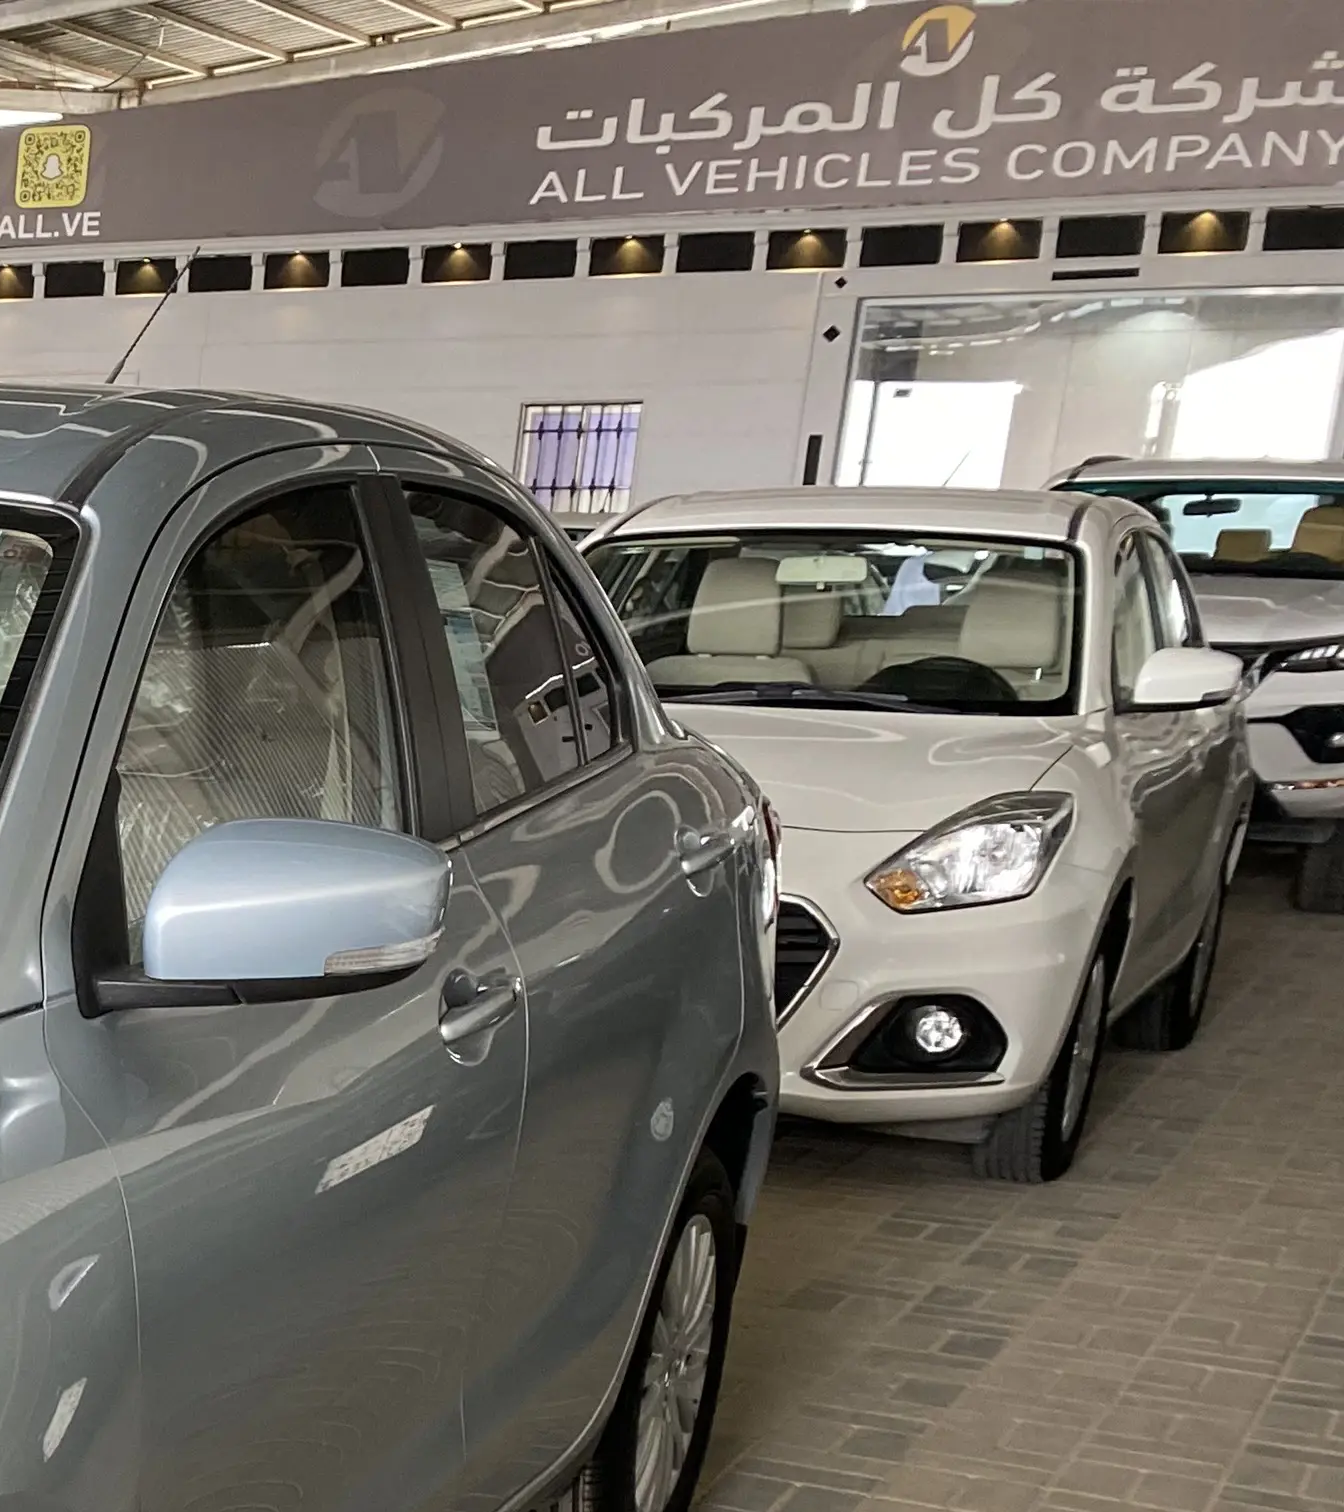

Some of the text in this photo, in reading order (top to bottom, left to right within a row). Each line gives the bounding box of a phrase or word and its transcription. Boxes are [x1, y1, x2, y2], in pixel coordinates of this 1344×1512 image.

[536, 50, 1344, 154] شركة كل المركبات
[529, 129, 1344, 205] ALL VEHICLES COMPANY
